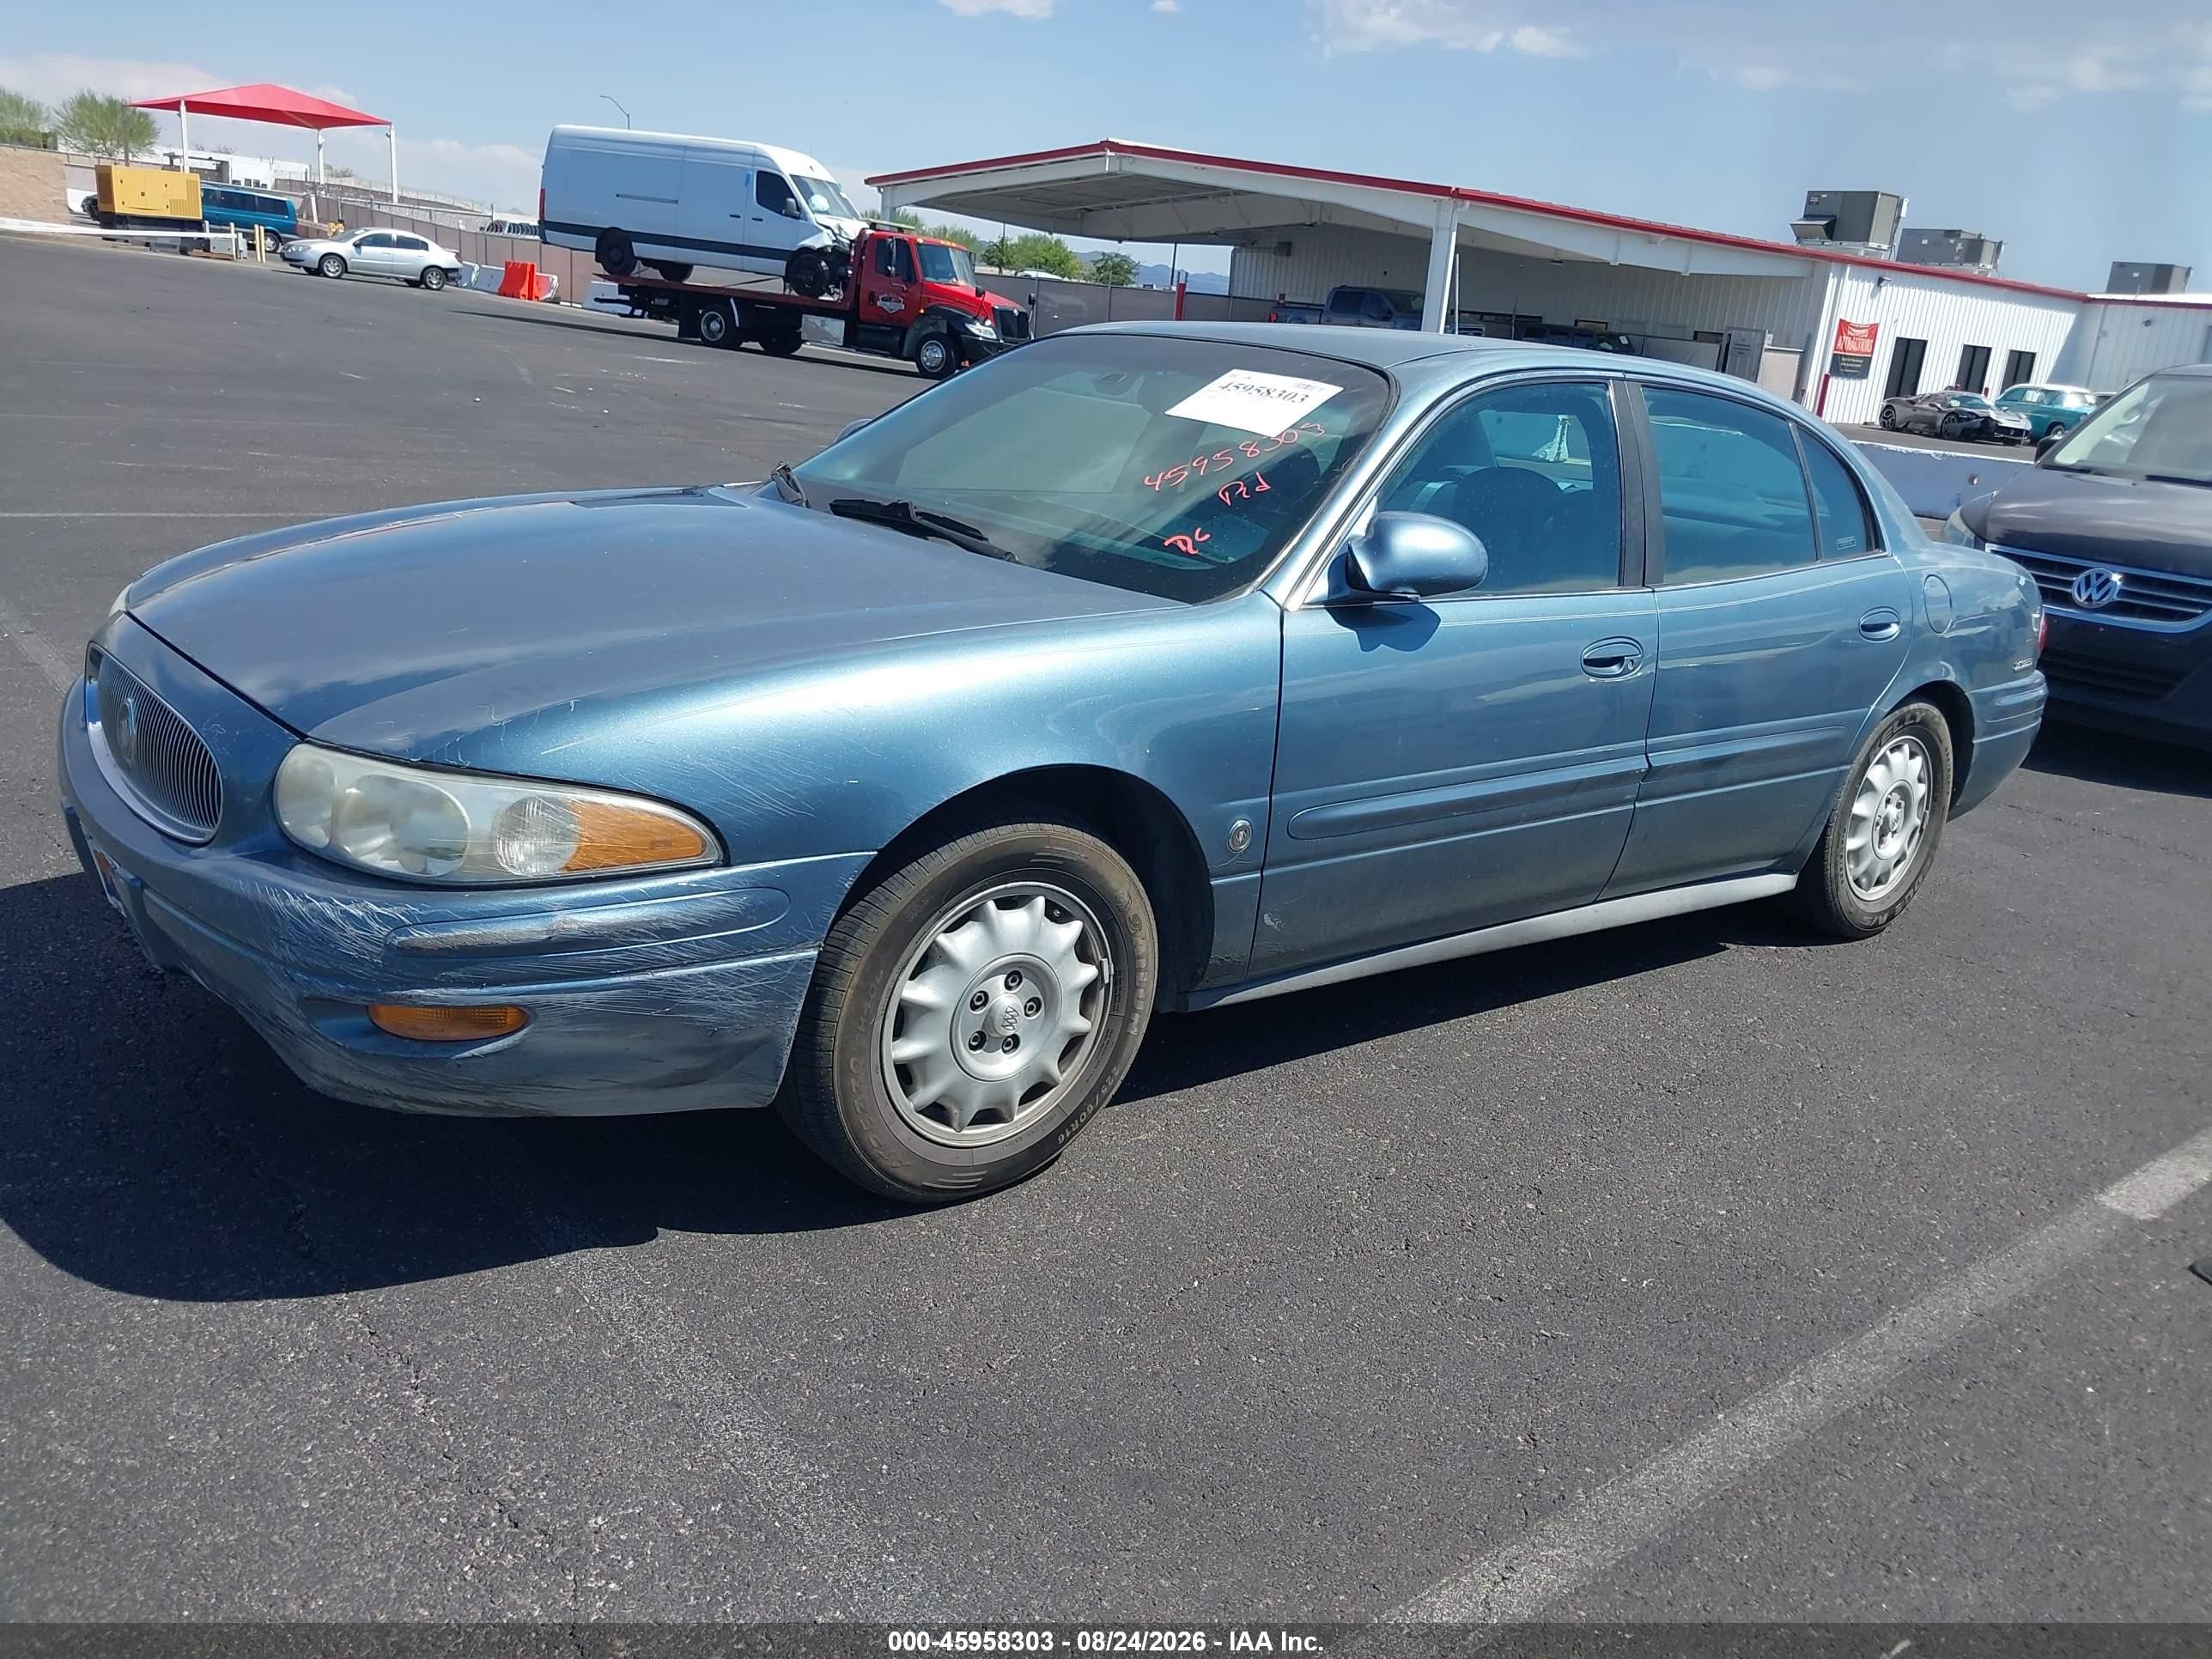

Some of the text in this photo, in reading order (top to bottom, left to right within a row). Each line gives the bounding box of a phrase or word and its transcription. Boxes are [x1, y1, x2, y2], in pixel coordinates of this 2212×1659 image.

[1218, 381, 1310, 404] 45958303
[1143, 422, 1326, 492] 45958303
[1056, 1065, 1120, 1146] 225/60R16
